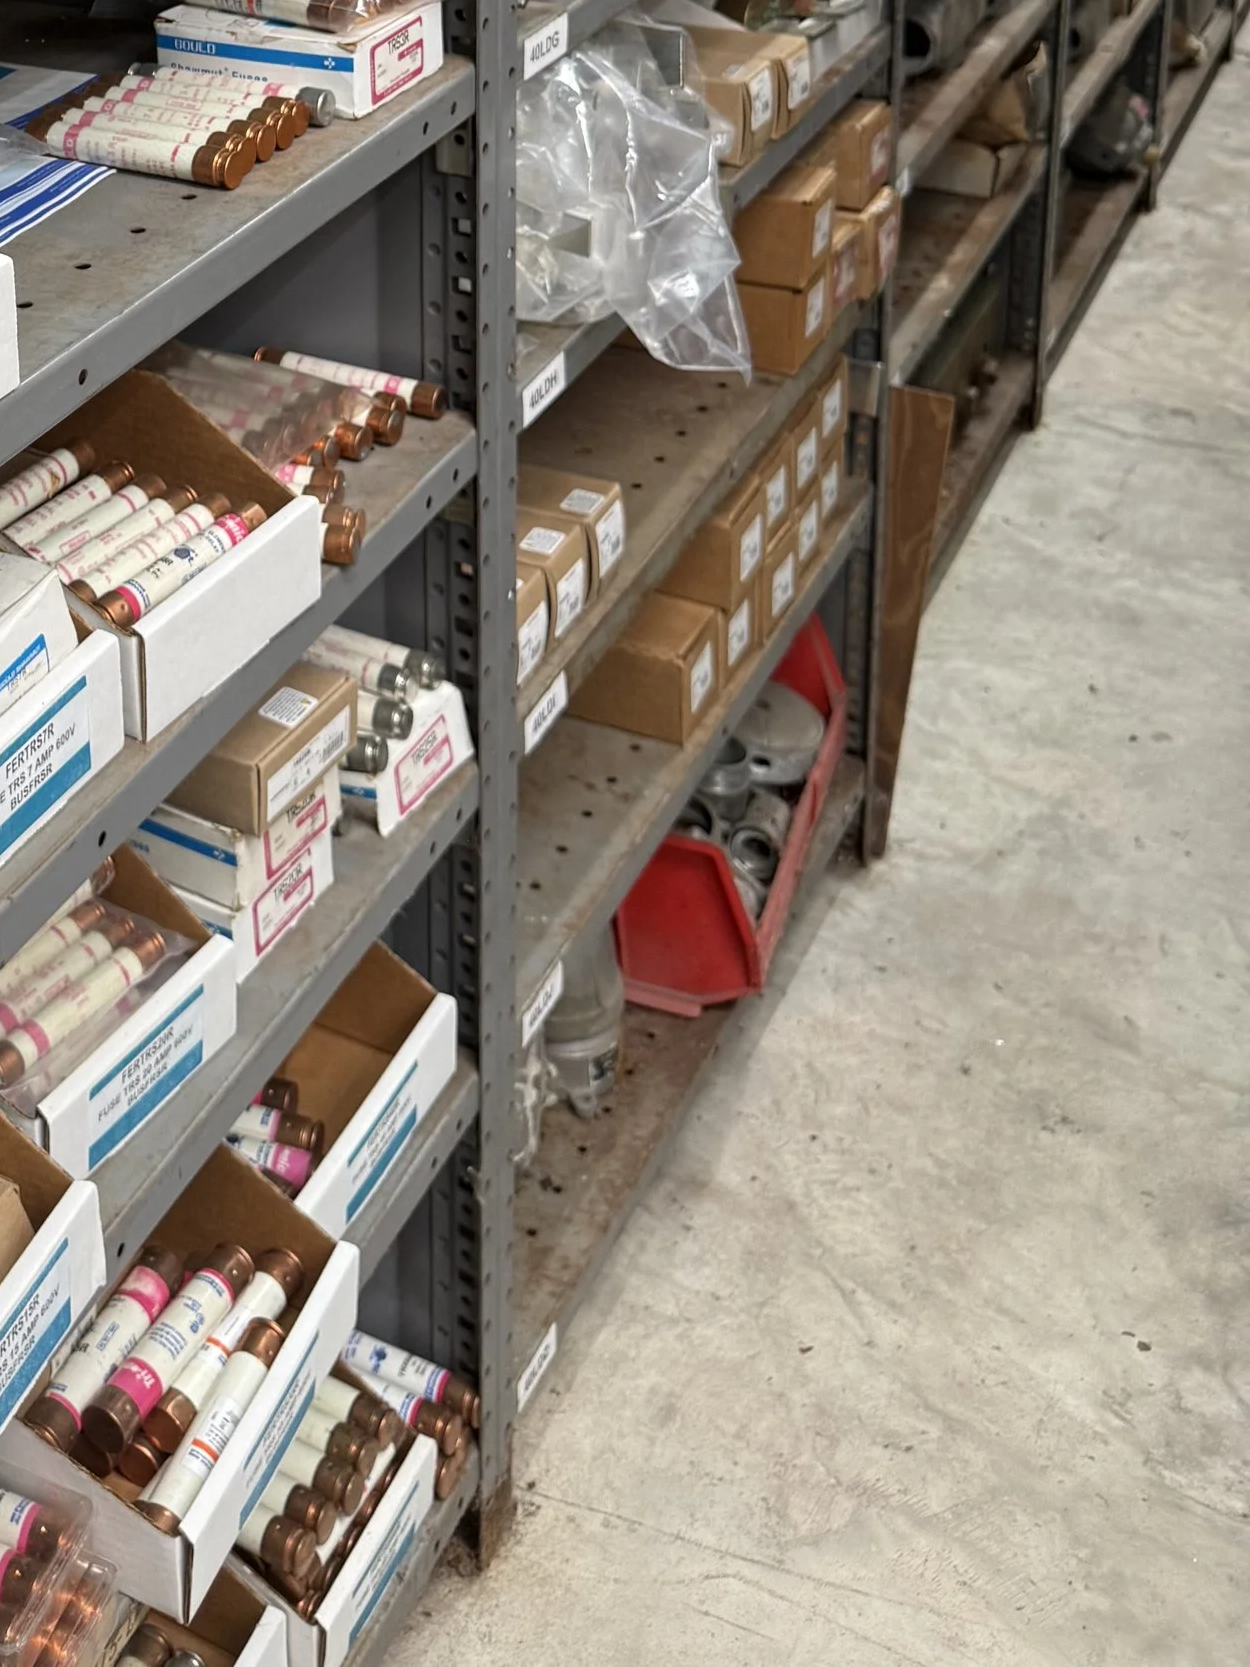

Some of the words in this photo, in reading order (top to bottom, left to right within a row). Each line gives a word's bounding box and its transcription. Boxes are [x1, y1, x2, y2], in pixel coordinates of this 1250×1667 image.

[174, 38, 215, 55] GOULD
[388, 31, 409, 54] TRS3R
[530, 30, 559, 62] 40LDG
[5, 722, 55, 779] FERTRS7R
[8, 775, 26, 798] TRS
[27, 768, 33, 781] 7
[34, 745, 54, 772] AMP
[56, 722, 76, 750] 600V
[10, 763, 53, 811] BUSFRSR
[98, 1093, 121, 1122] FUSE
[11, 1344, 20, 1359] 15
[21, 1314, 39, 1343] AMP
